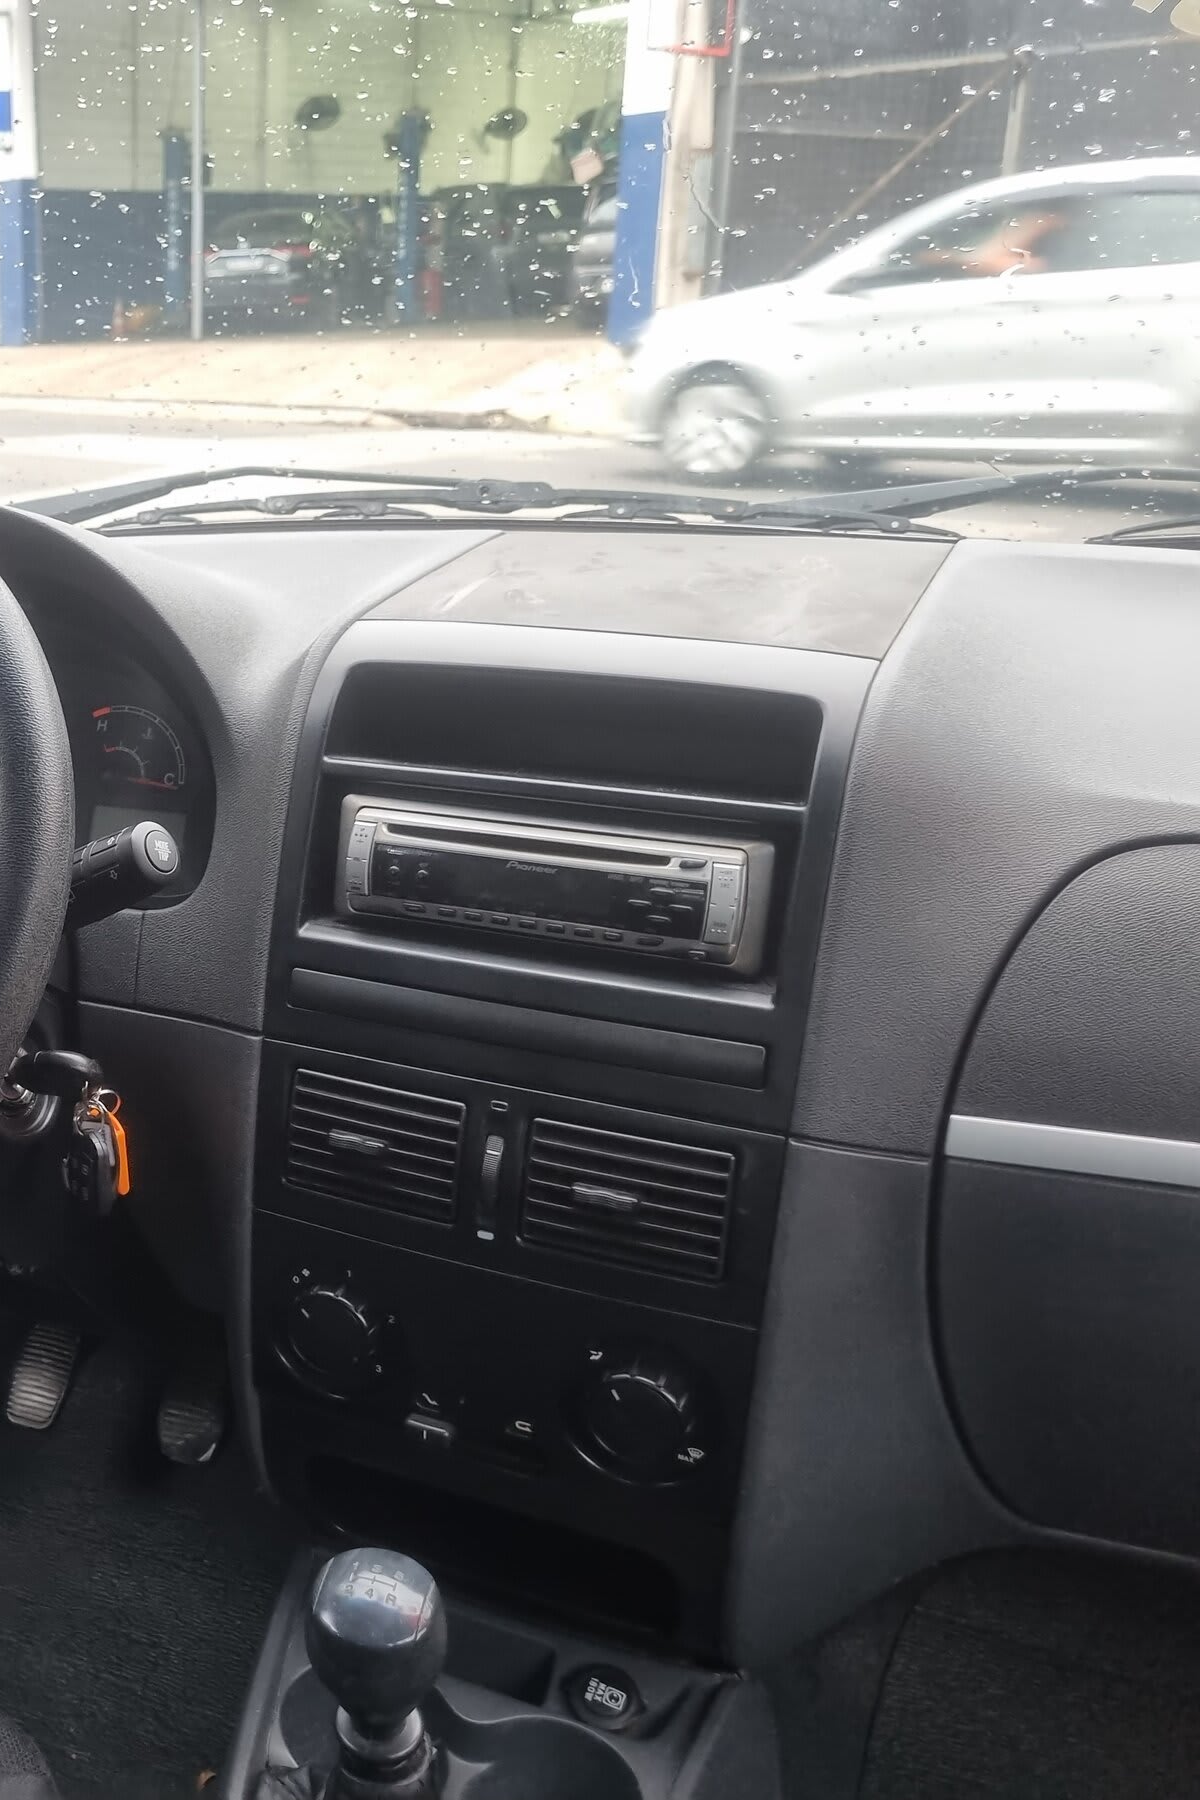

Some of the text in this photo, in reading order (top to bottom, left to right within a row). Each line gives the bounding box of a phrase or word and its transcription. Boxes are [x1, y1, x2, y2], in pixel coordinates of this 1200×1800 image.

[96, 719, 108, 731] H
[163, 773, 175, 785] C
[505, 860, 558, 874] Pioneer
[292, 1275, 300, 1283] 0
[388, 1315, 395, 1323] 2
[375, 1364, 382, 1373] 3
[353, 1561, 359, 1570] 1
[364, 1588, 374, 1599] 4
[385, 1592, 397, 1606] R
